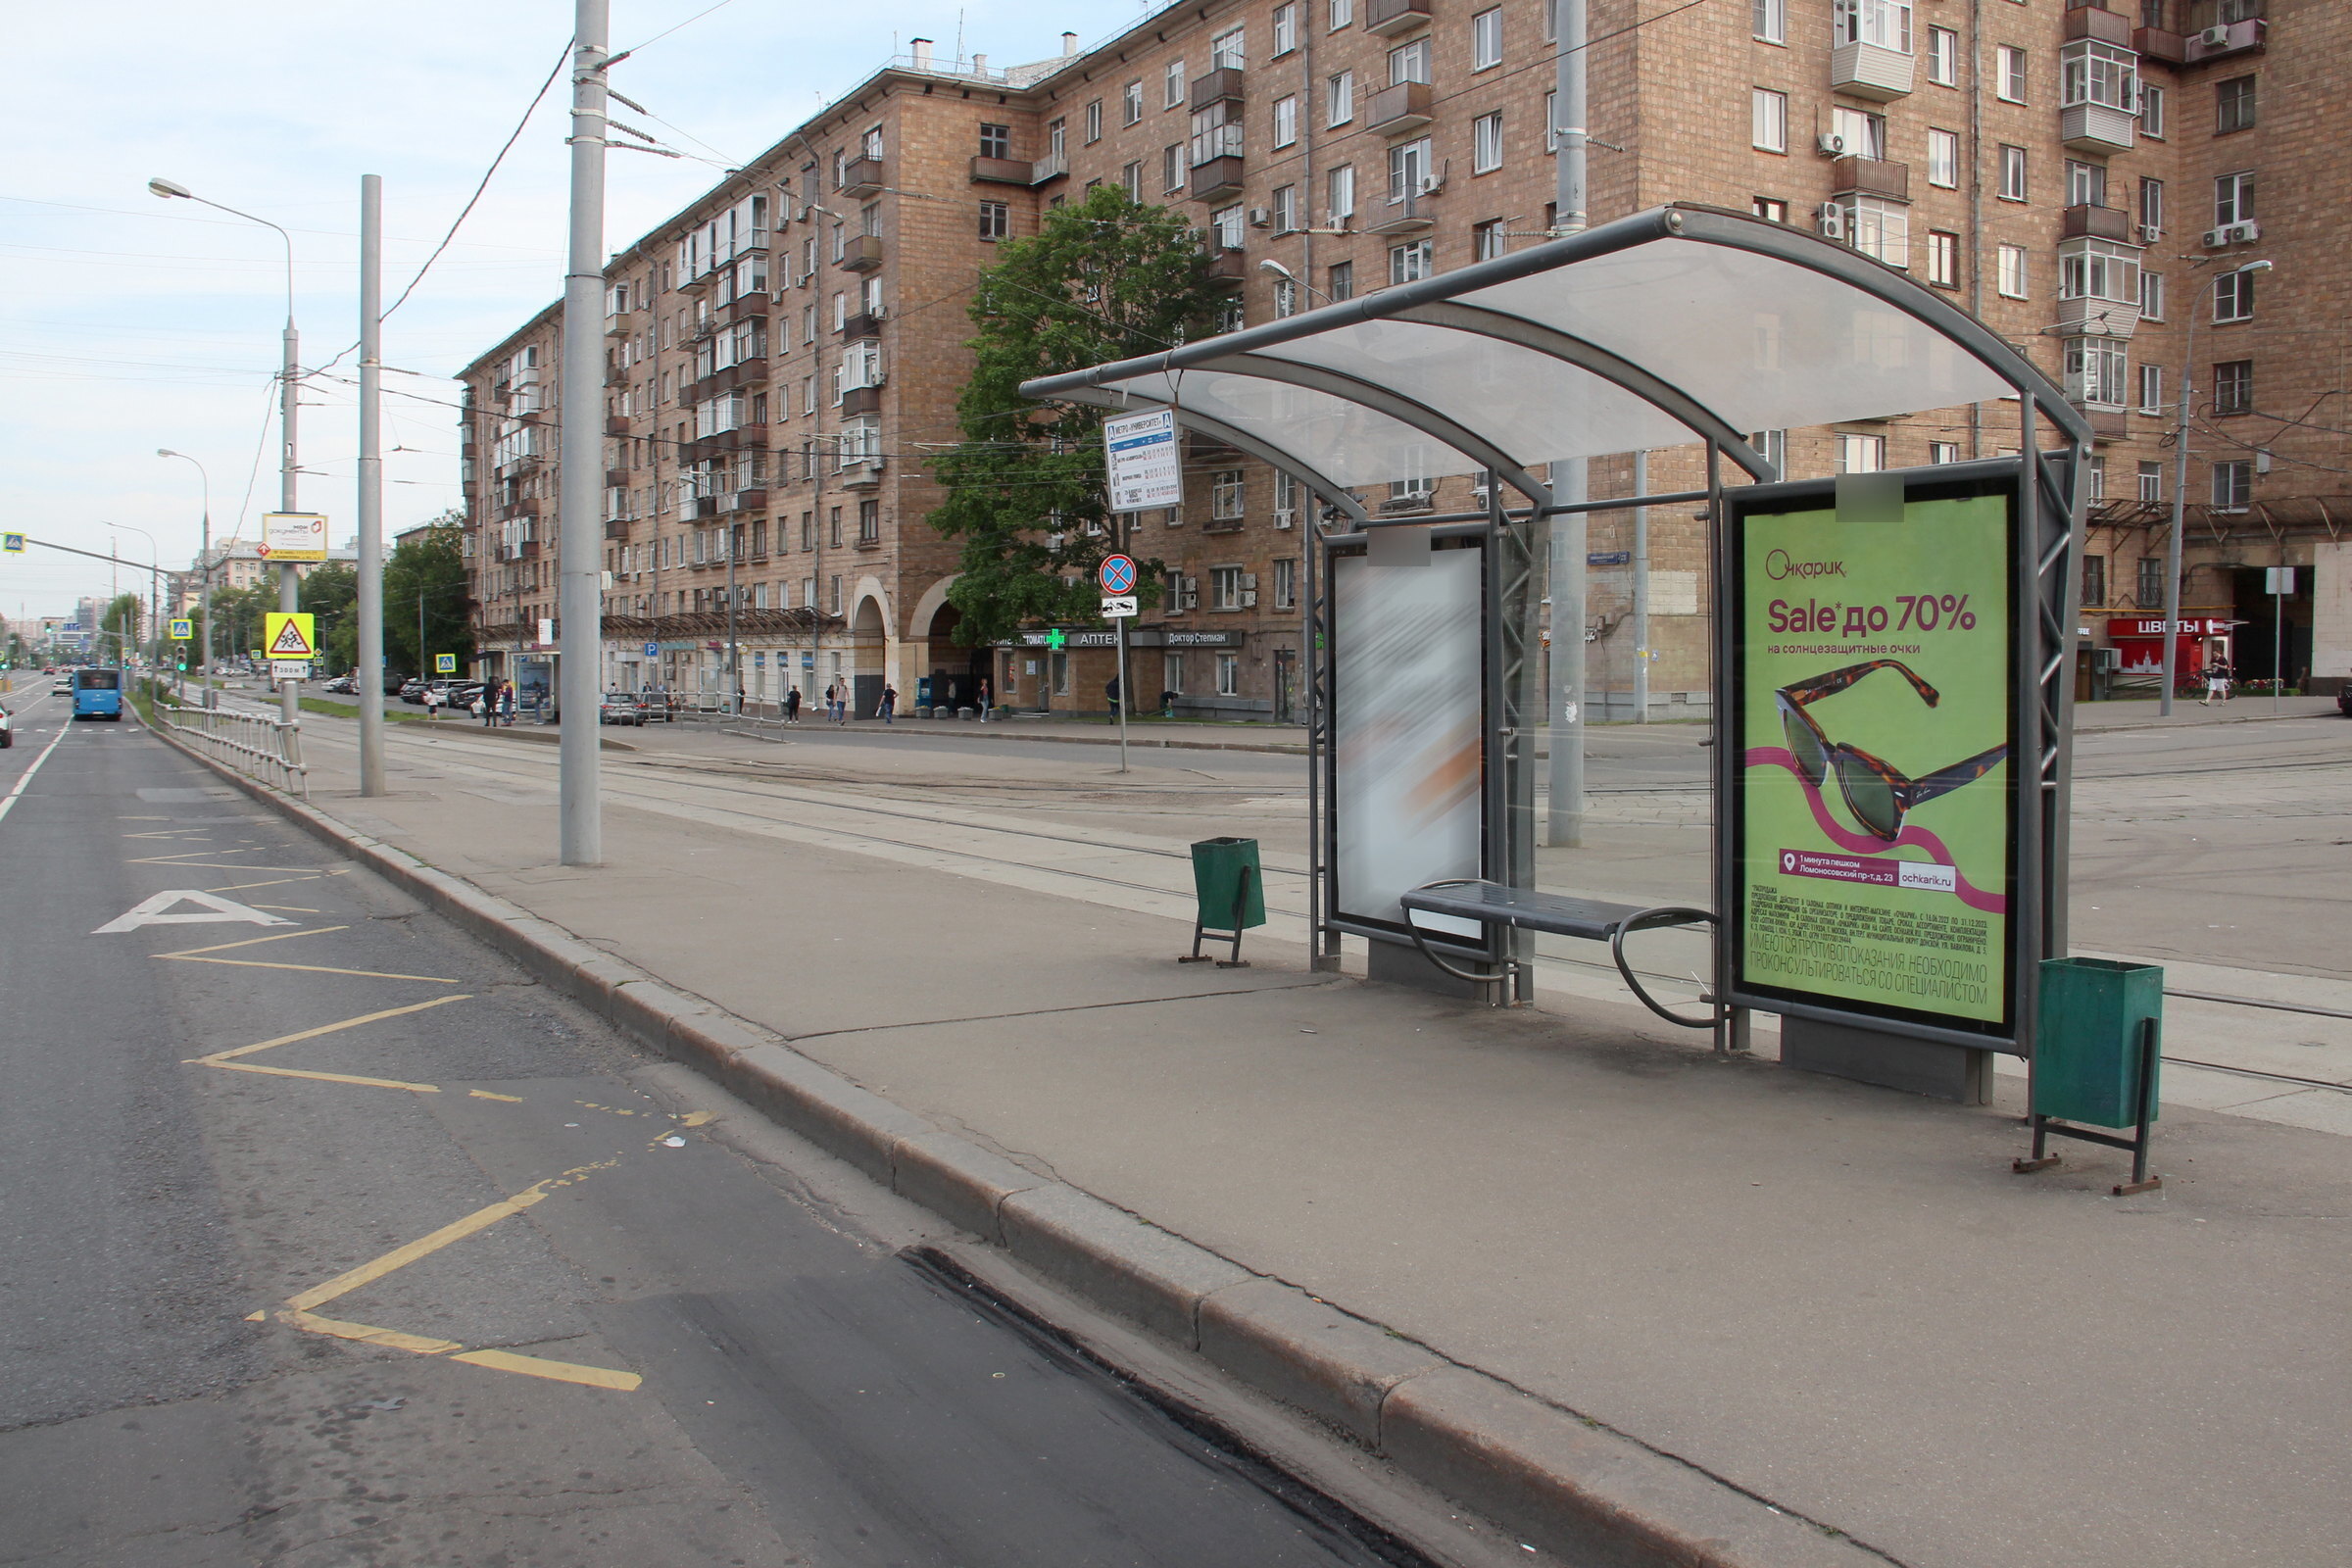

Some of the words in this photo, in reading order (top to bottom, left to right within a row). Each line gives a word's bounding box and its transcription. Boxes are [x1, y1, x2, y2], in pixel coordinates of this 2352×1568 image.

[1766, 549, 1845, 580] Очкарик
[1842, 606, 1888, 638] до
[1895, 594, 1976, 631] 70%
[2138, 620, 2199, 633] ЦВТЫ
[1168, 633, 1194, 645] Доктор
[1768, 645, 1780, 655] на
[1783, 644, 1887, 657] солнцезащитные
[1889, 644, 1921, 655] очки
[1803, 855, 1831, 866] минута
[1831, 858, 1860, 868] пешком
[1799, 864, 1857, 878] Ломоносовский
[1884, 872, 1893, 882] 23
[1901, 872, 1952, 887] ochkarik.ru
[1750, 933, 1797, 955] ИМЕЮТСЯ
[1909, 955, 1987, 984] НЕОБХОДИМО
[1750, 951, 1876, 986] ПРОКОНСУЛЬТИРОВАТЬСЯ
[1878, 970, 1893, 990] СО
[1895, 974, 1987, 1004] СПЕЦИАЛИСТОМ
